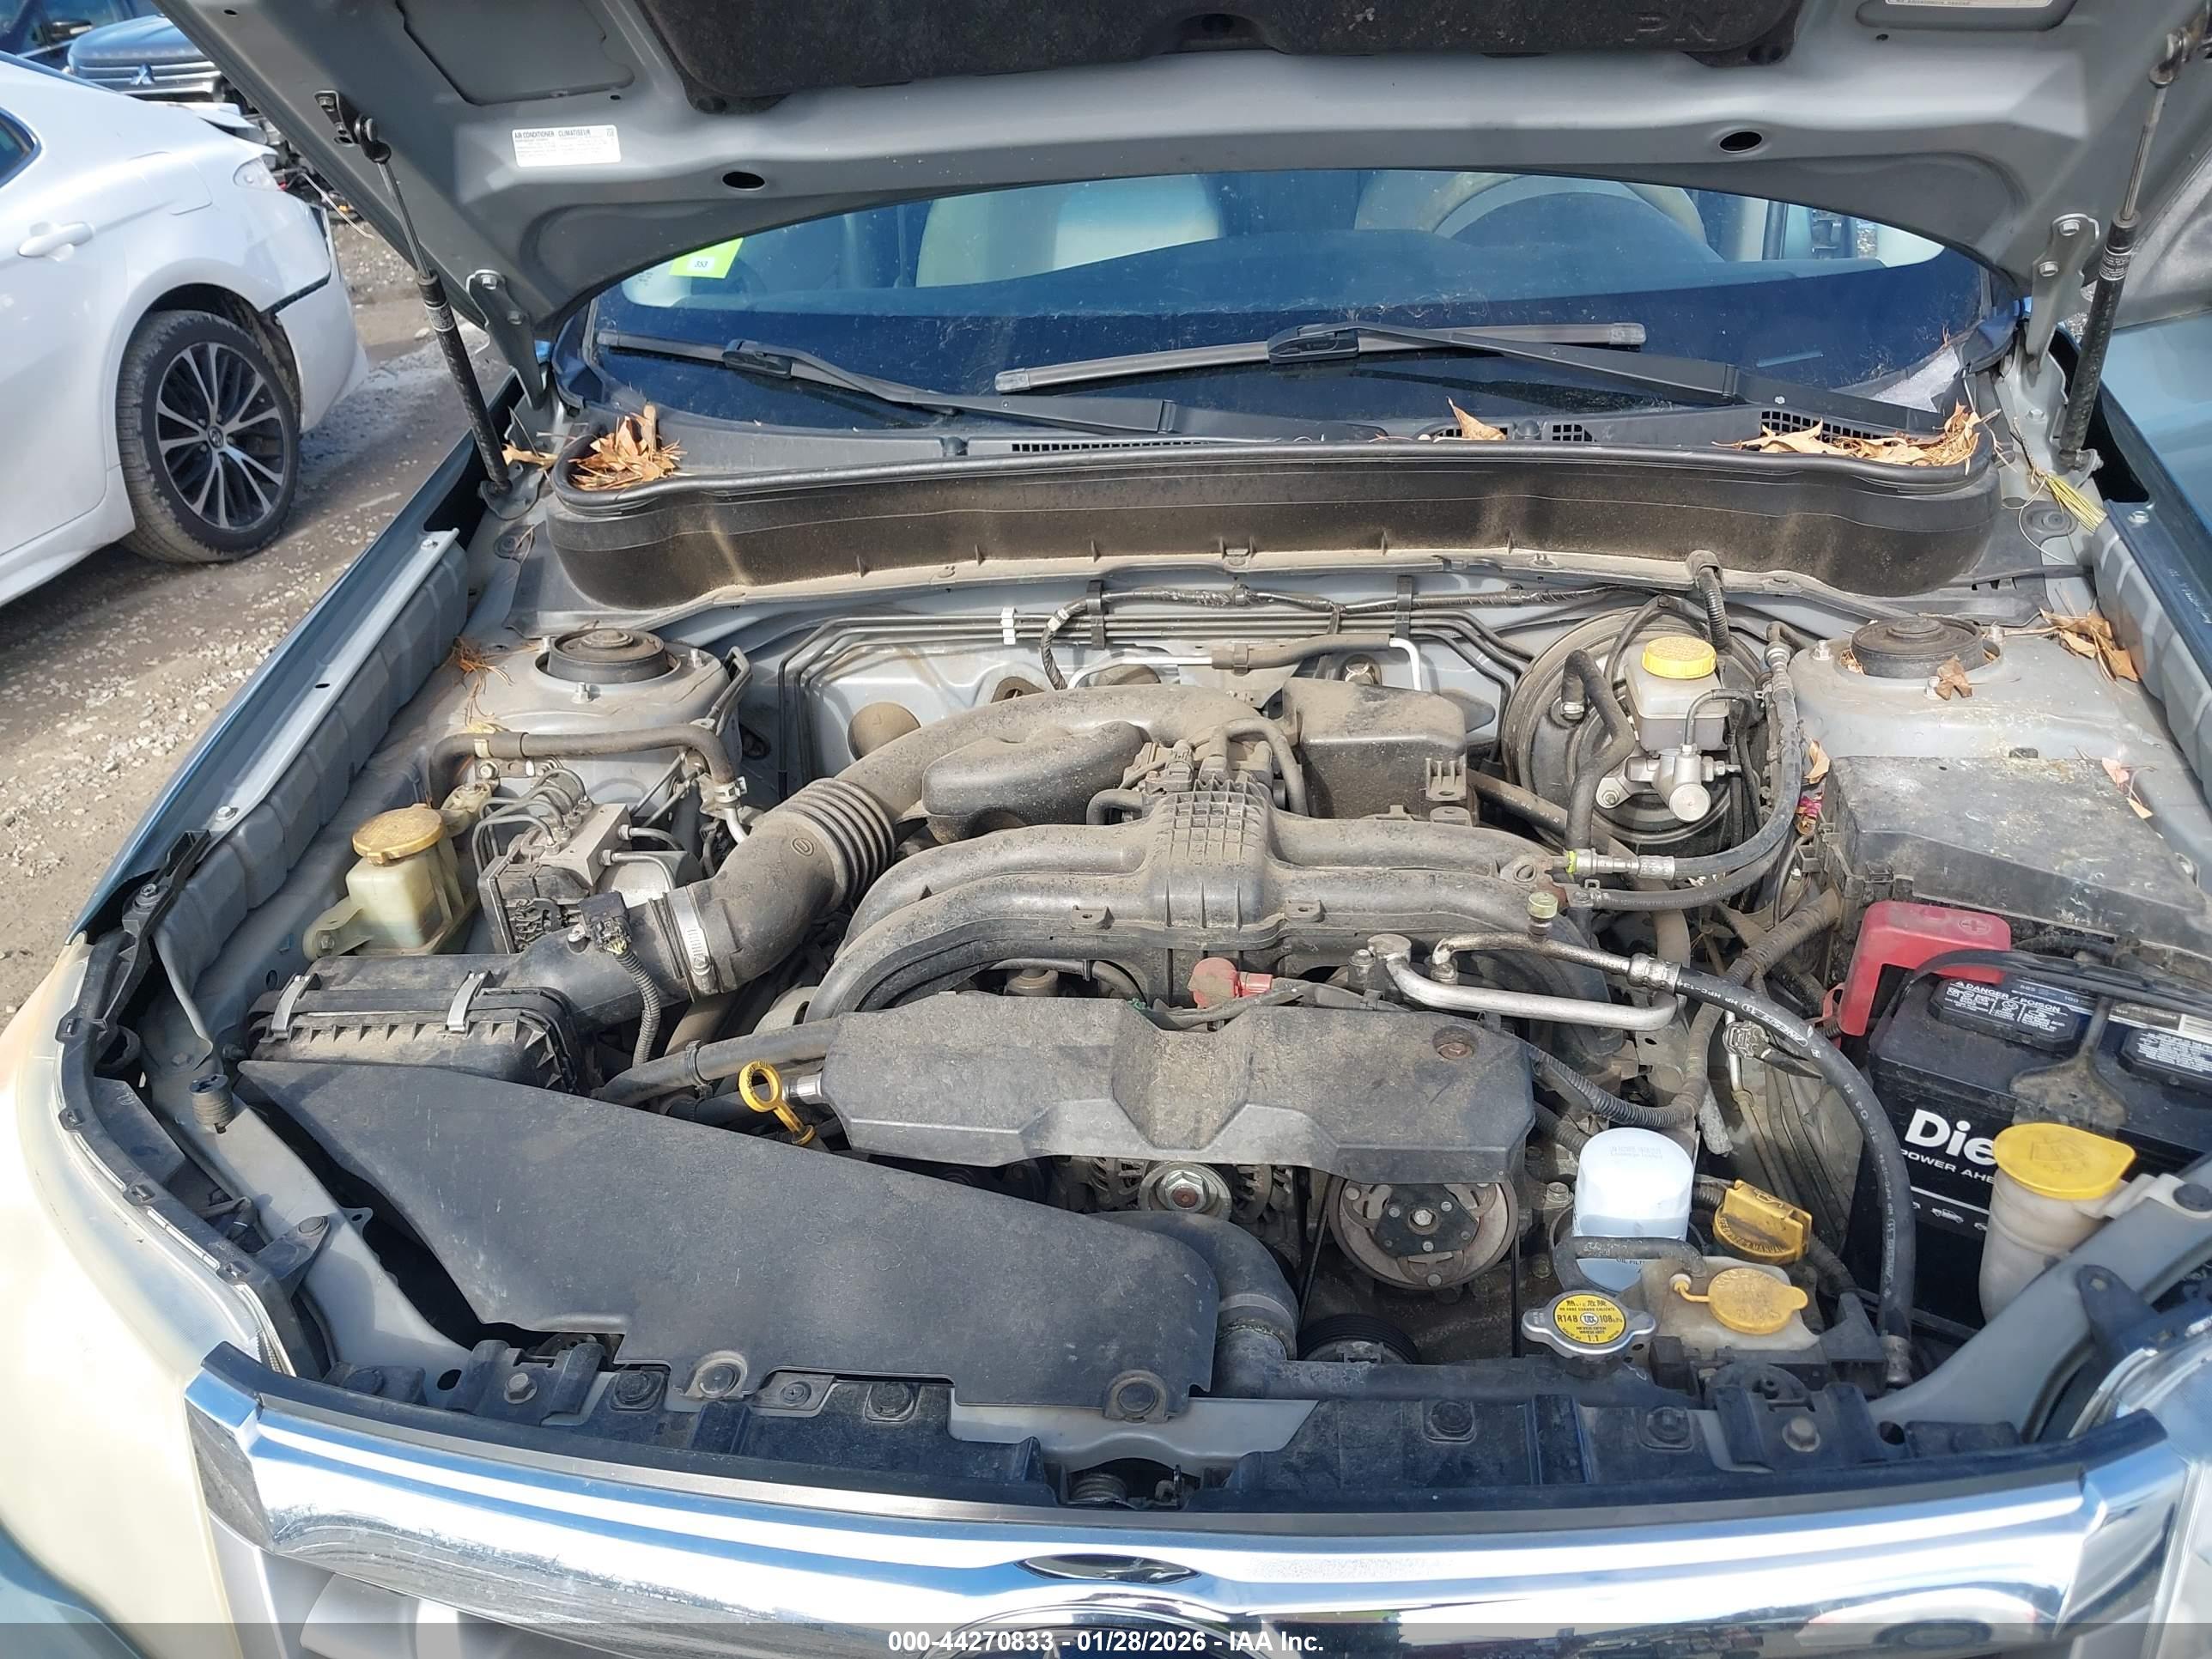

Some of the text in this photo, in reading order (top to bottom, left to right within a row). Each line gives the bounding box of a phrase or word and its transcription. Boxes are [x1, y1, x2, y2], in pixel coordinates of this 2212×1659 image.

[1966, 982, 2009, 1000] DANGER
[2020, 997, 2062, 1013] POISON
[1752, 1243, 1785, 1254] MANUAL
[1557, 1314, 1578, 1323] R148
